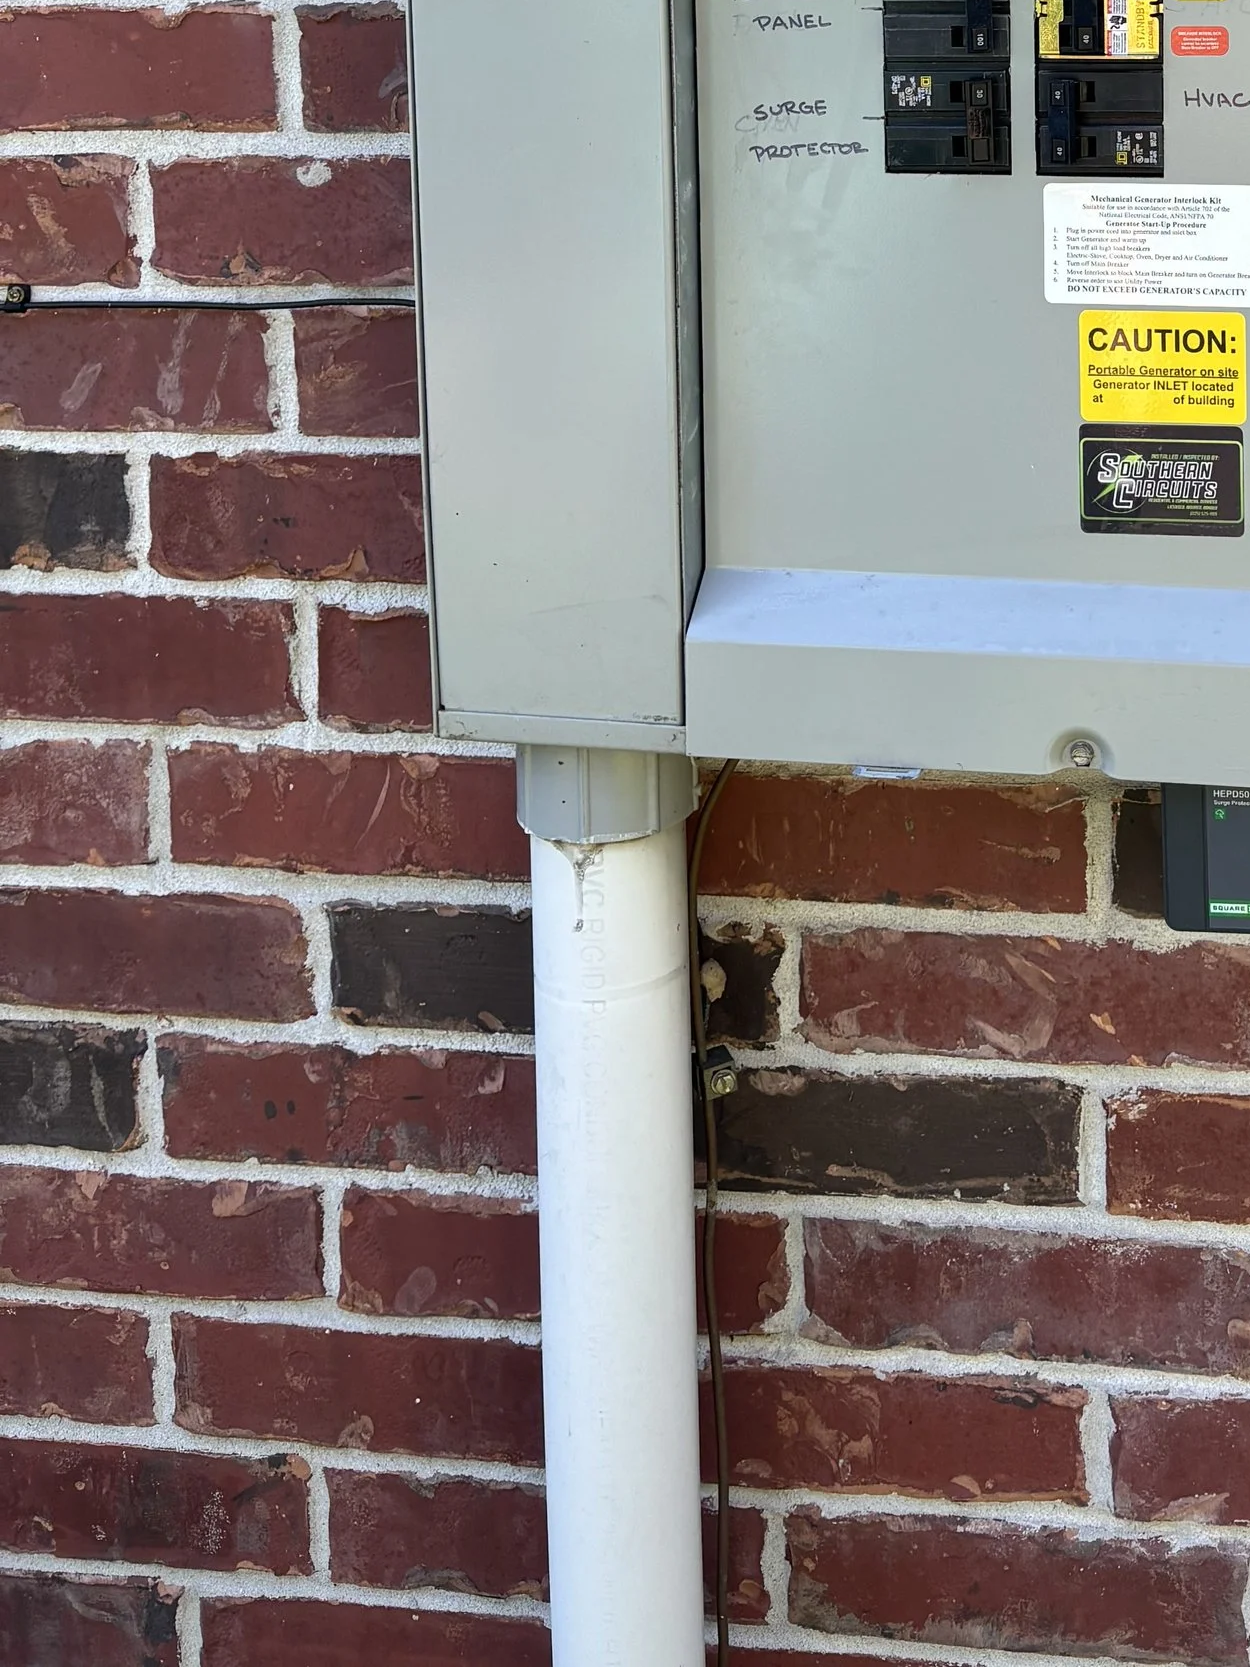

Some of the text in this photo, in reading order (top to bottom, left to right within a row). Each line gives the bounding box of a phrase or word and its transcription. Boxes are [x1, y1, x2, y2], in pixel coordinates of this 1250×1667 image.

[752, 14, 832, 31] PANEL
[1136, 0, 1145, 49] STANDBY
[1083, 34, 1090, 44] 40
[1054, 90, 1061, 100] 40
[1184, 88, 1250, 108] HVAC
[753, 100, 827, 121] SURGE
[749, 142, 869, 162] PROTECTOR
[1056, 147, 1063, 156] 40
[1091, 195, 1132, 203] Mechanical
[1134, 196, 1172, 204] Generator
[1209, 197, 1221, 205] Kit
[1141, 220, 1171, 229] Start-Up
[1172, 221, 1207, 229] Procedure
[1154, 254, 1171, 262] Dryer
[1082, 285, 1101, 293] NOT
[1139, 286, 1200, 295] GENERATOR'S
[1202, 288, 1247, 296] CAPACITY
[1088, 327, 1236, 354] CAUTION:
[1088, 364, 1239, 377] Portable Generator on site
[1093, 379, 1234, 392] Generator INLET located
[1092, 394, 1235, 408] at of building
[1097, 452, 1213, 483] SOUTHERN
[1113, 478, 1218, 509] CIRCUITS
[1213, 789, 1250, 799] HEPD50
[1213, 799, 1231, 807] Surge
[1212, 904, 1246, 912] SQUARE
